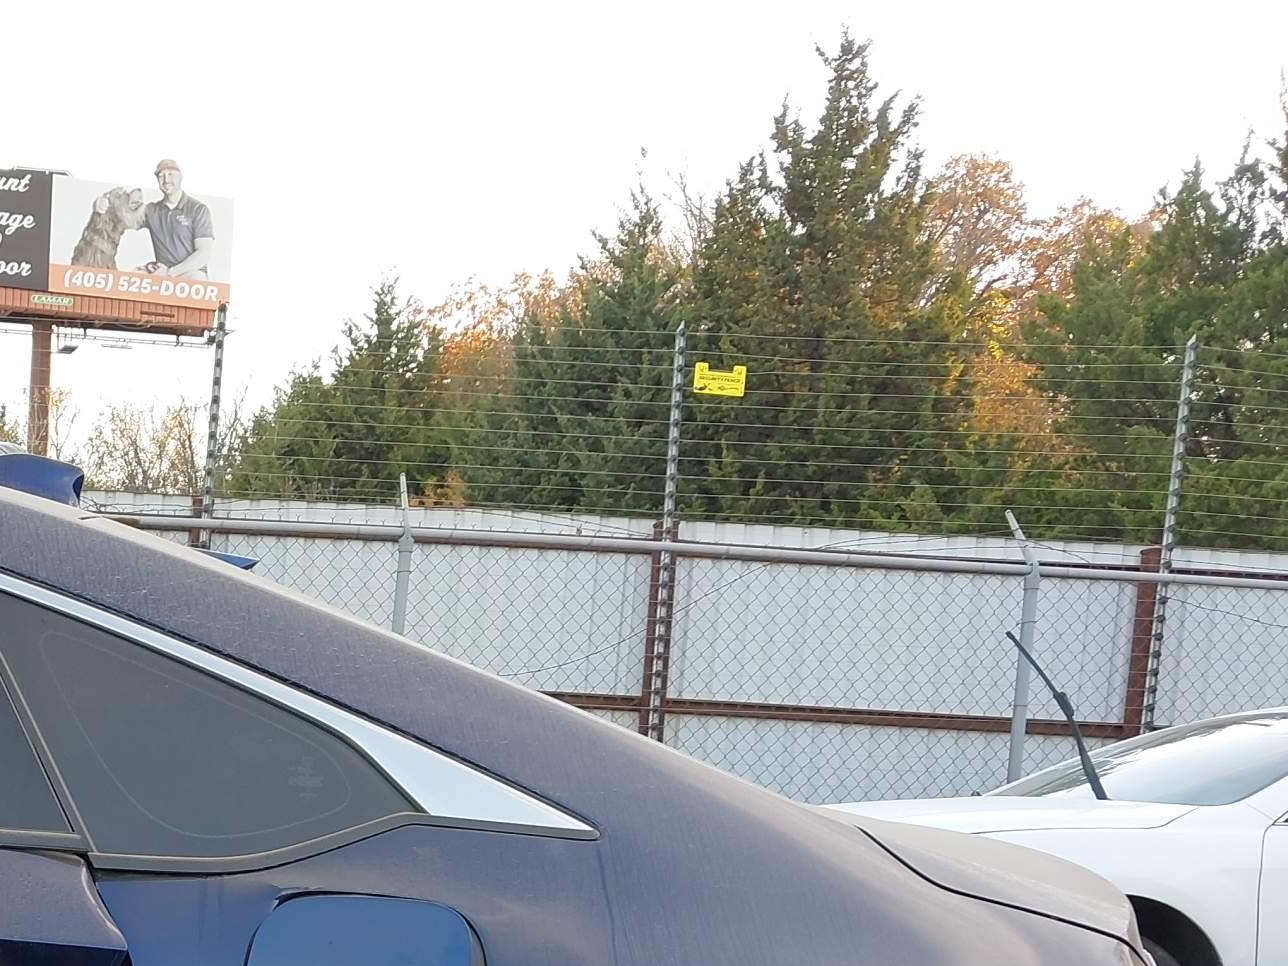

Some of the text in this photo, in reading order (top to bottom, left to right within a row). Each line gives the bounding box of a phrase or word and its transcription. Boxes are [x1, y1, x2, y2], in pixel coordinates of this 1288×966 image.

[63, 269, 219, 302] (405) 525-DOOR
[34, 294, 68, 305] LAMAR
